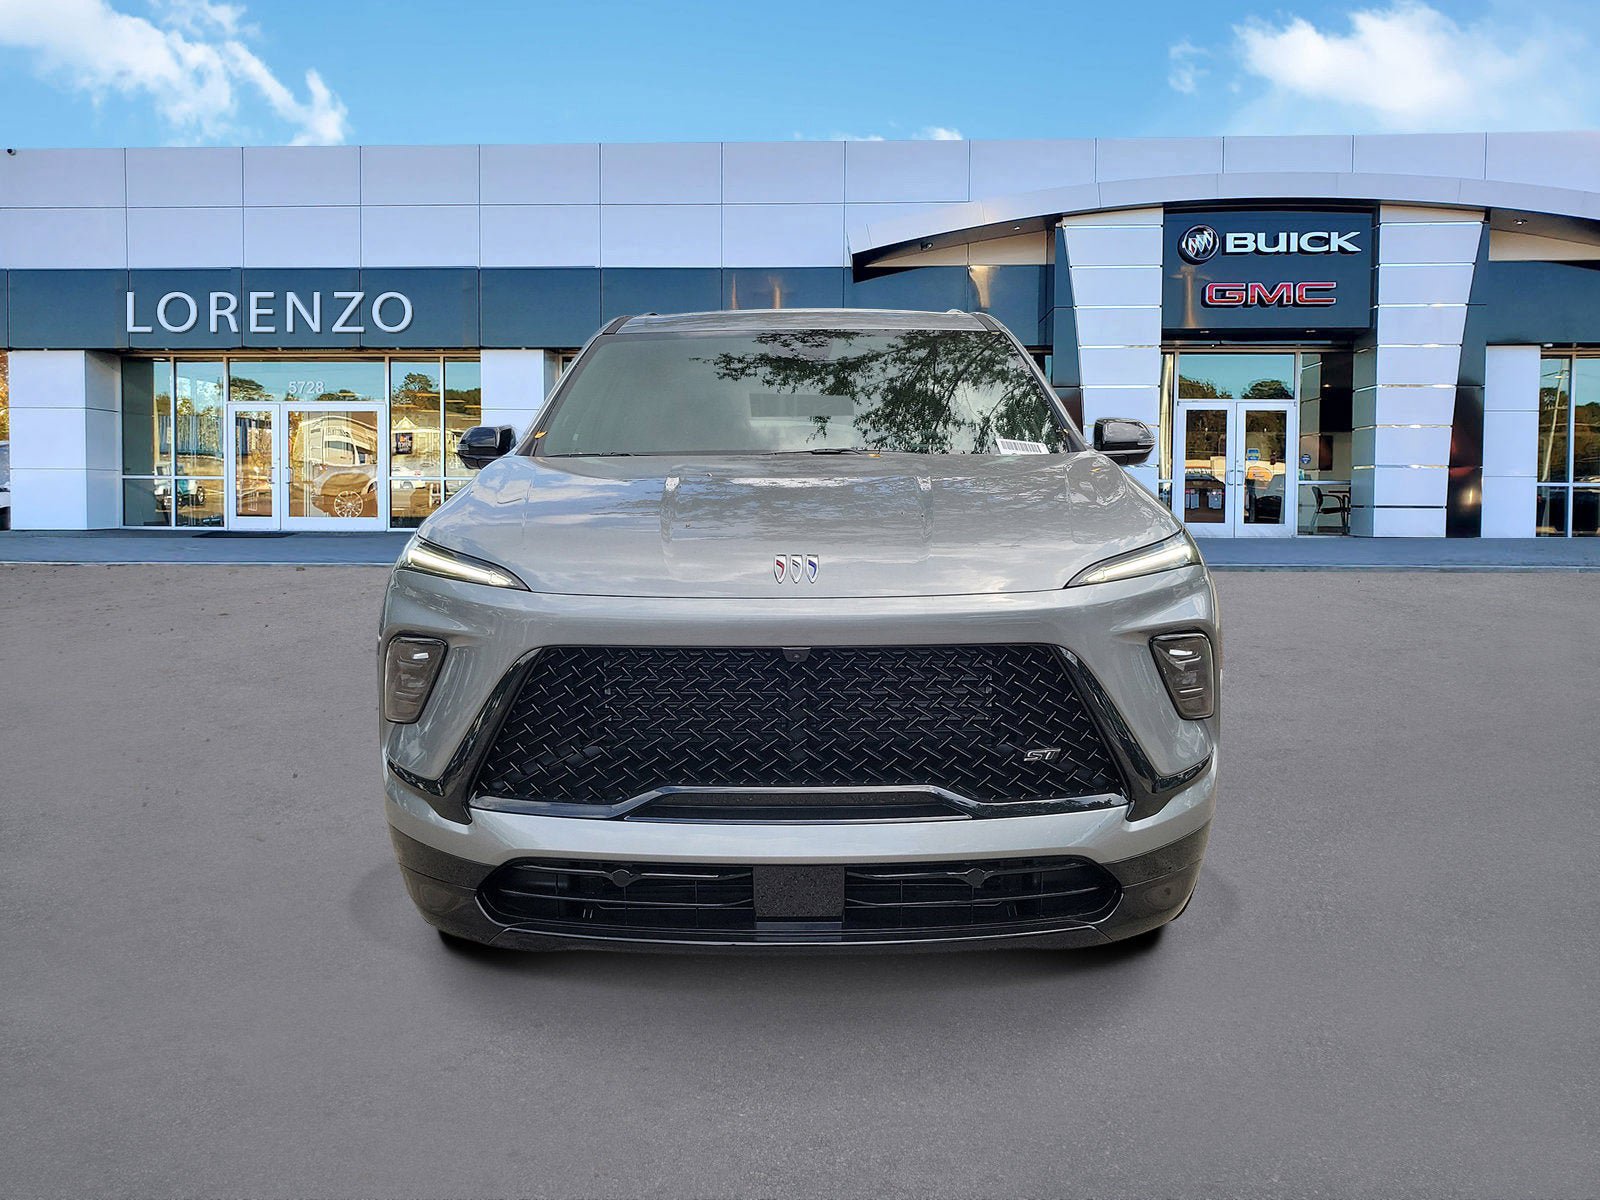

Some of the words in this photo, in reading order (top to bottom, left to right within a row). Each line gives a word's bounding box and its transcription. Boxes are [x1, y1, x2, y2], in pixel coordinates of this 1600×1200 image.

[1225, 231, 1361, 253] BUICK
[1205, 281, 1337, 305] GMC
[126, 291, 413, 333] LORENZO
[288, 380, 325, 395] 5728
[1023, 748, 1061, 762] ST
